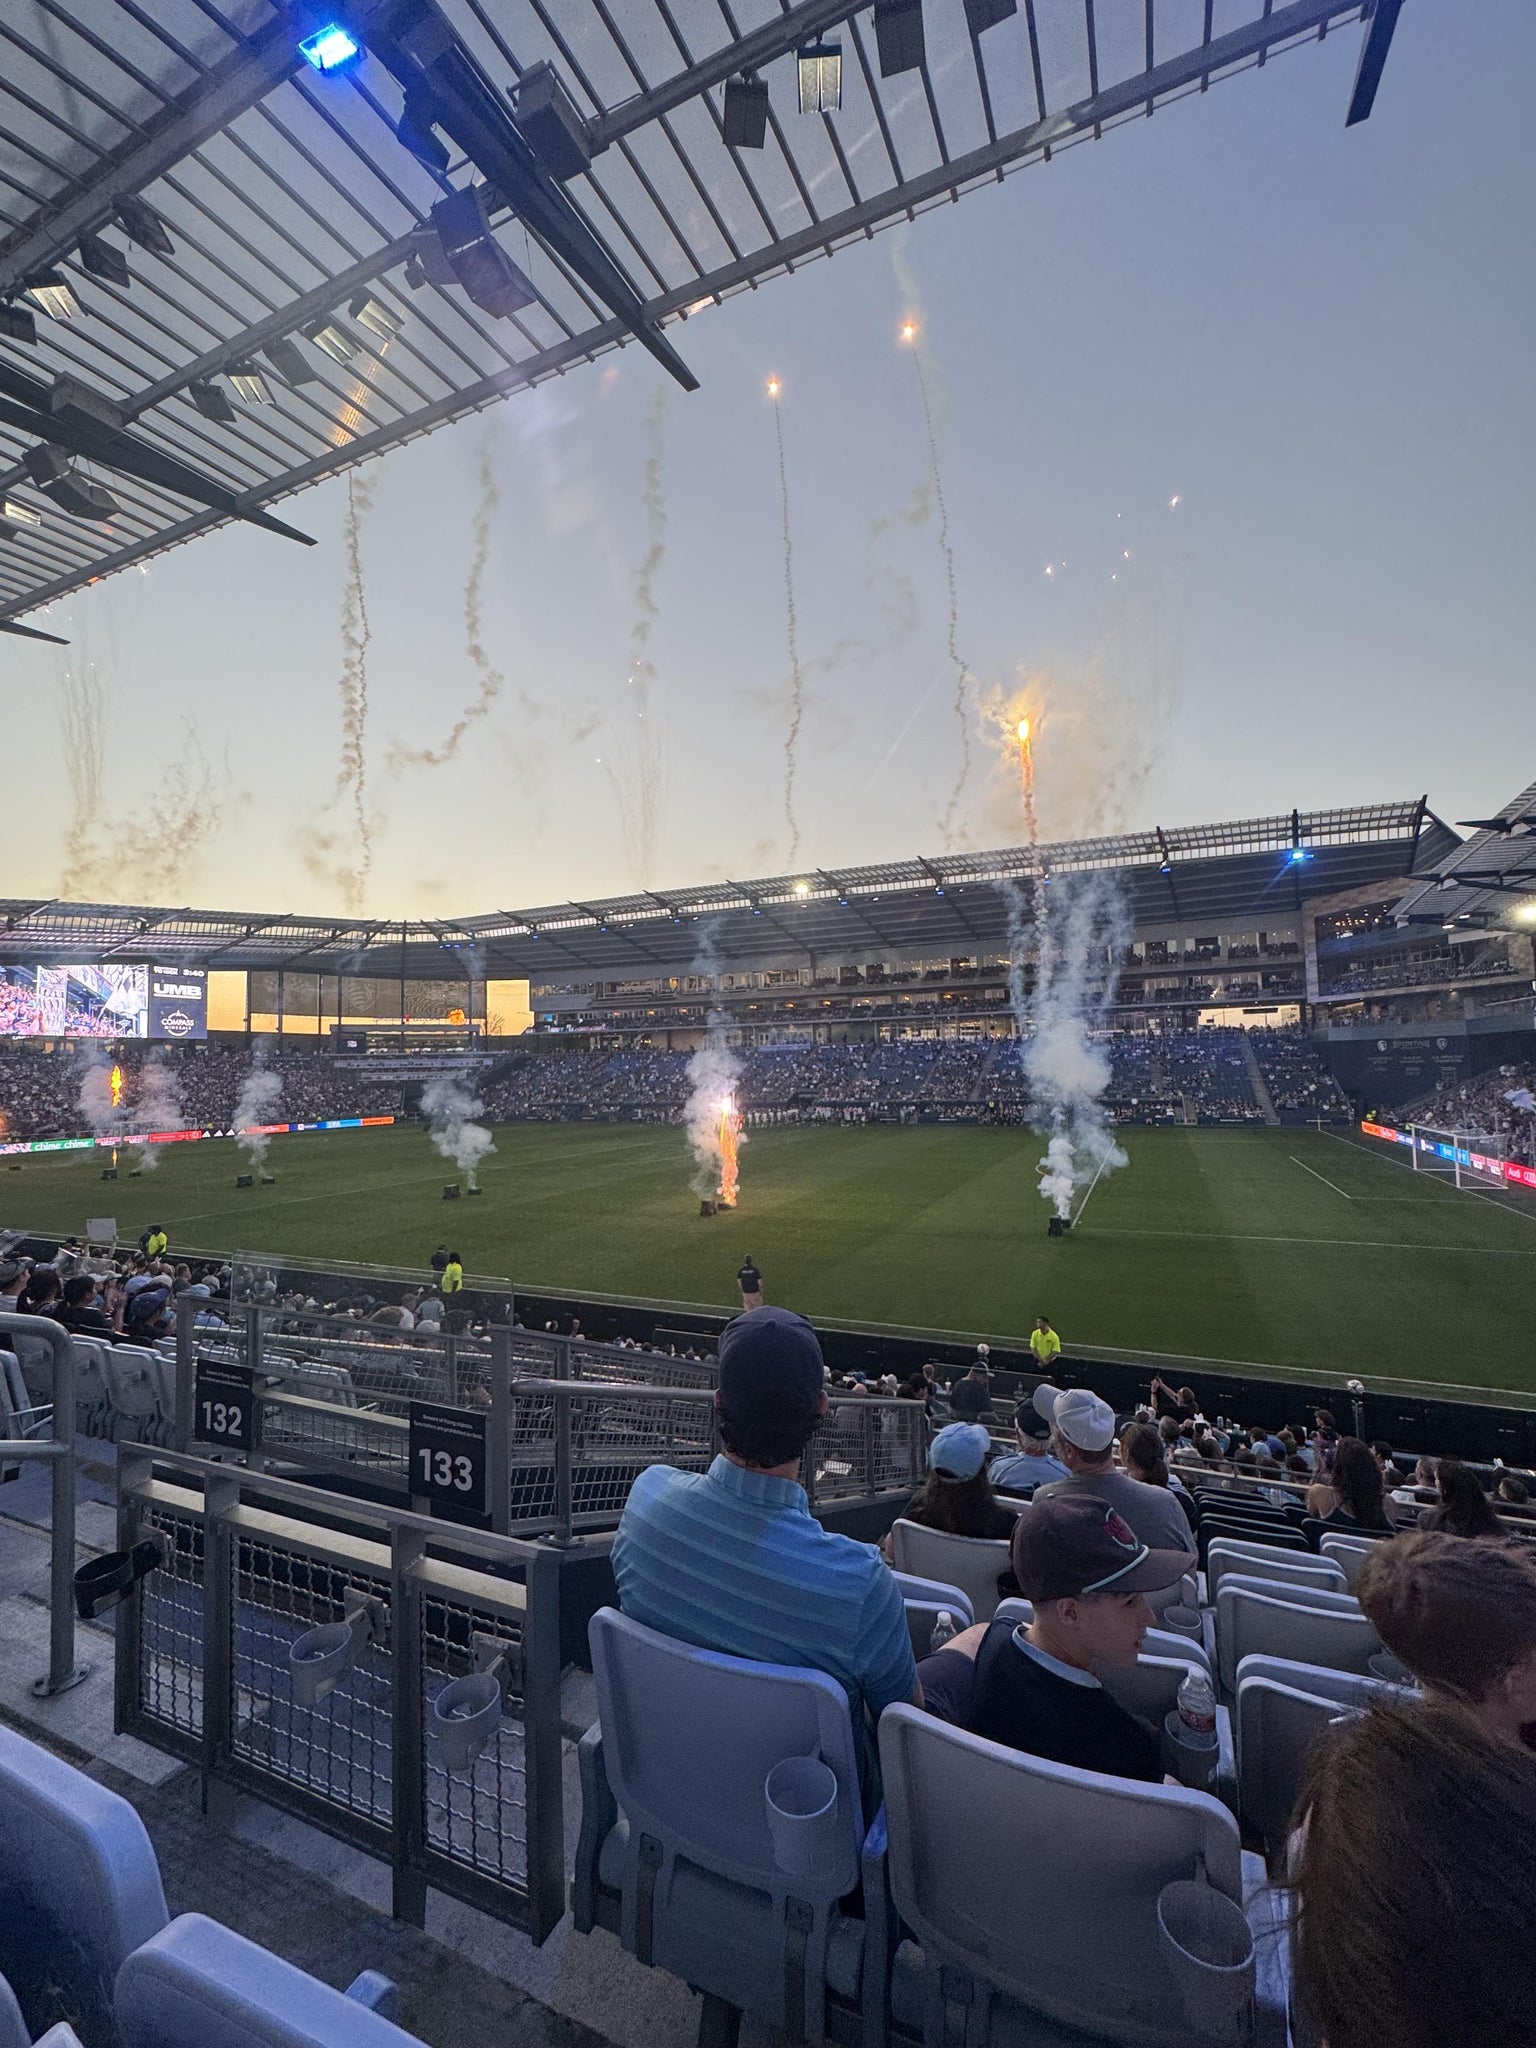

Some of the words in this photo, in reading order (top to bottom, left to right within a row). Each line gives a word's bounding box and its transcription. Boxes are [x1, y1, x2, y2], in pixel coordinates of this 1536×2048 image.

[153, 982, 202, 996] UMB
[161, 1018, 195, 1027] COMPASS
[35, 1142, 62, 1151] chime
[63, 1139, 89, 1149] chime
[1508, 1166, 1521, 1178] Audi
[202, 1401, 242, 1437] 132
[418, 1448, 473, 1492] 133
